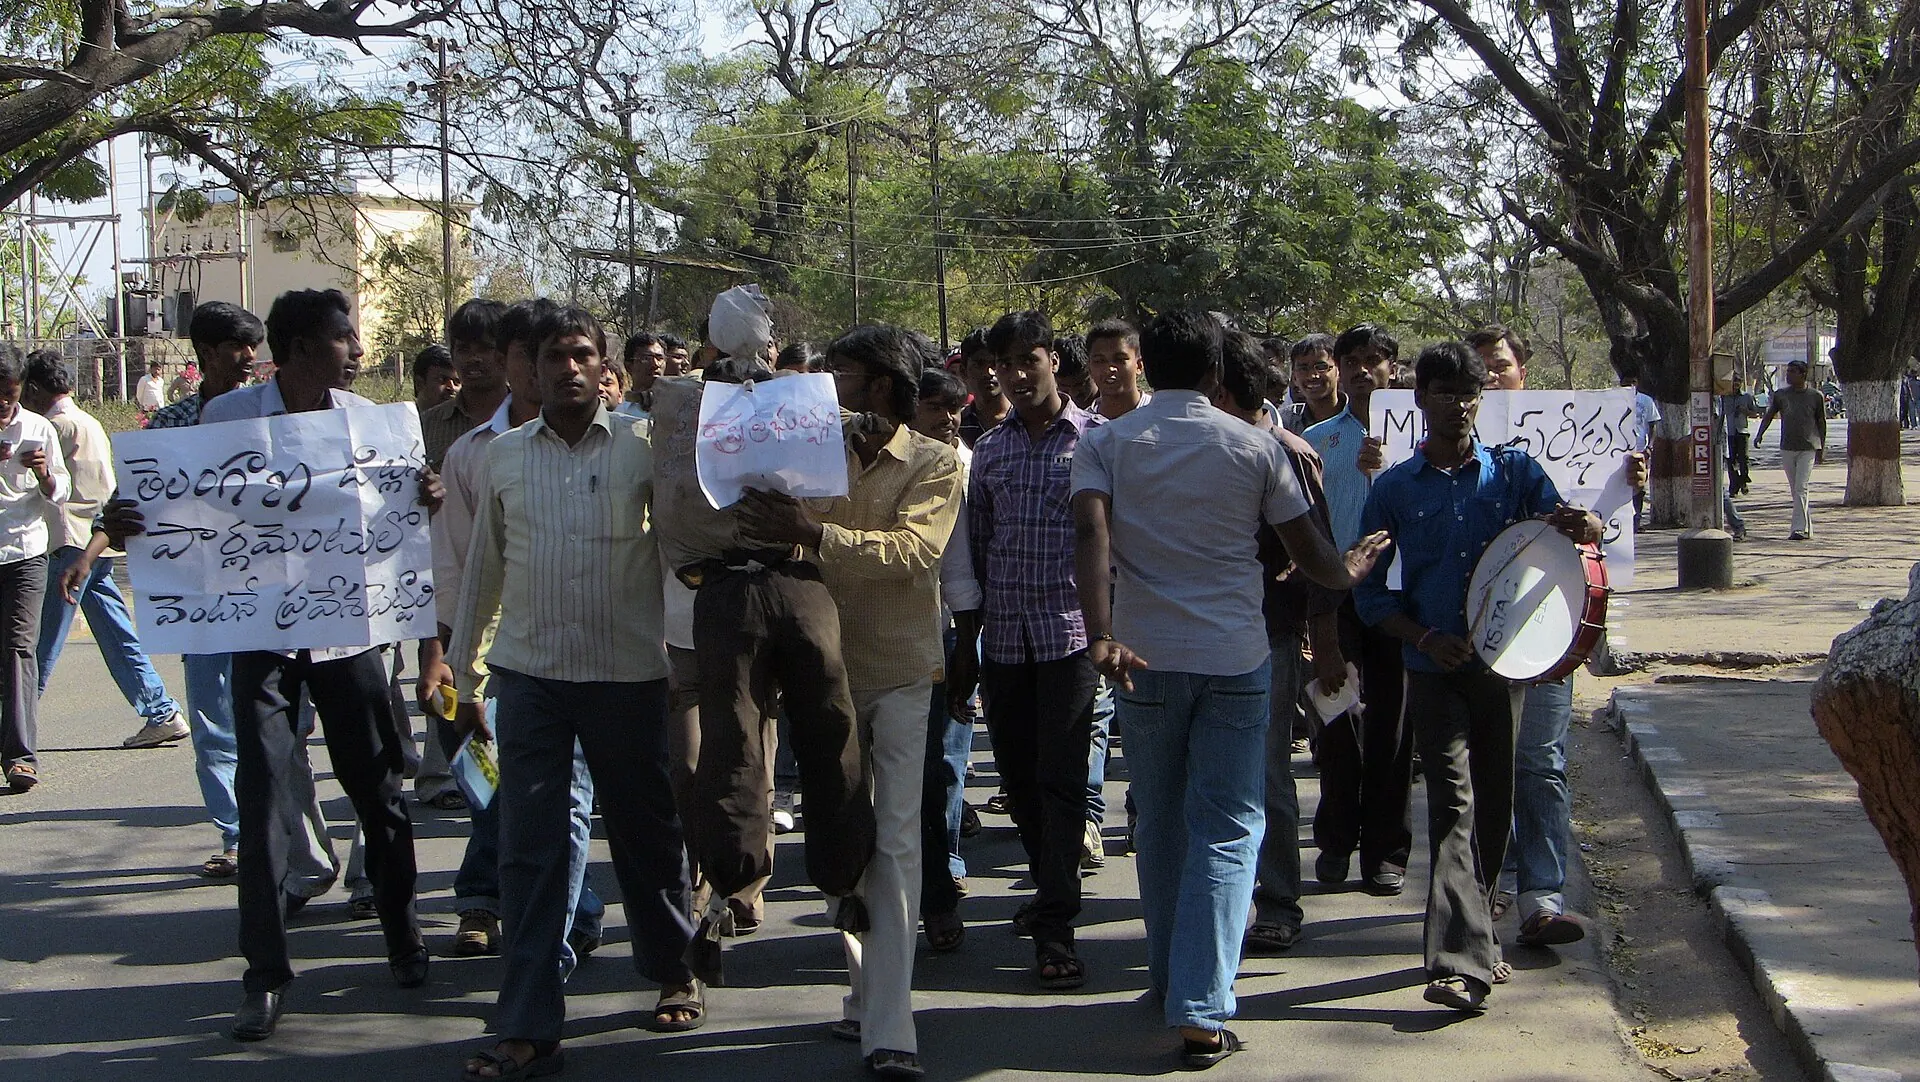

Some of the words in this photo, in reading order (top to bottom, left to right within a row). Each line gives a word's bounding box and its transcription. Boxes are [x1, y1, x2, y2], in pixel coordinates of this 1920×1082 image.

[1694, 428, 1709, 474] GRE
[124, 451, 311, 512] తెలంగాణ
[147, 502, 420, 571] పార్లమెంటులో
[148, 576, 259, 626] వెంటనే
